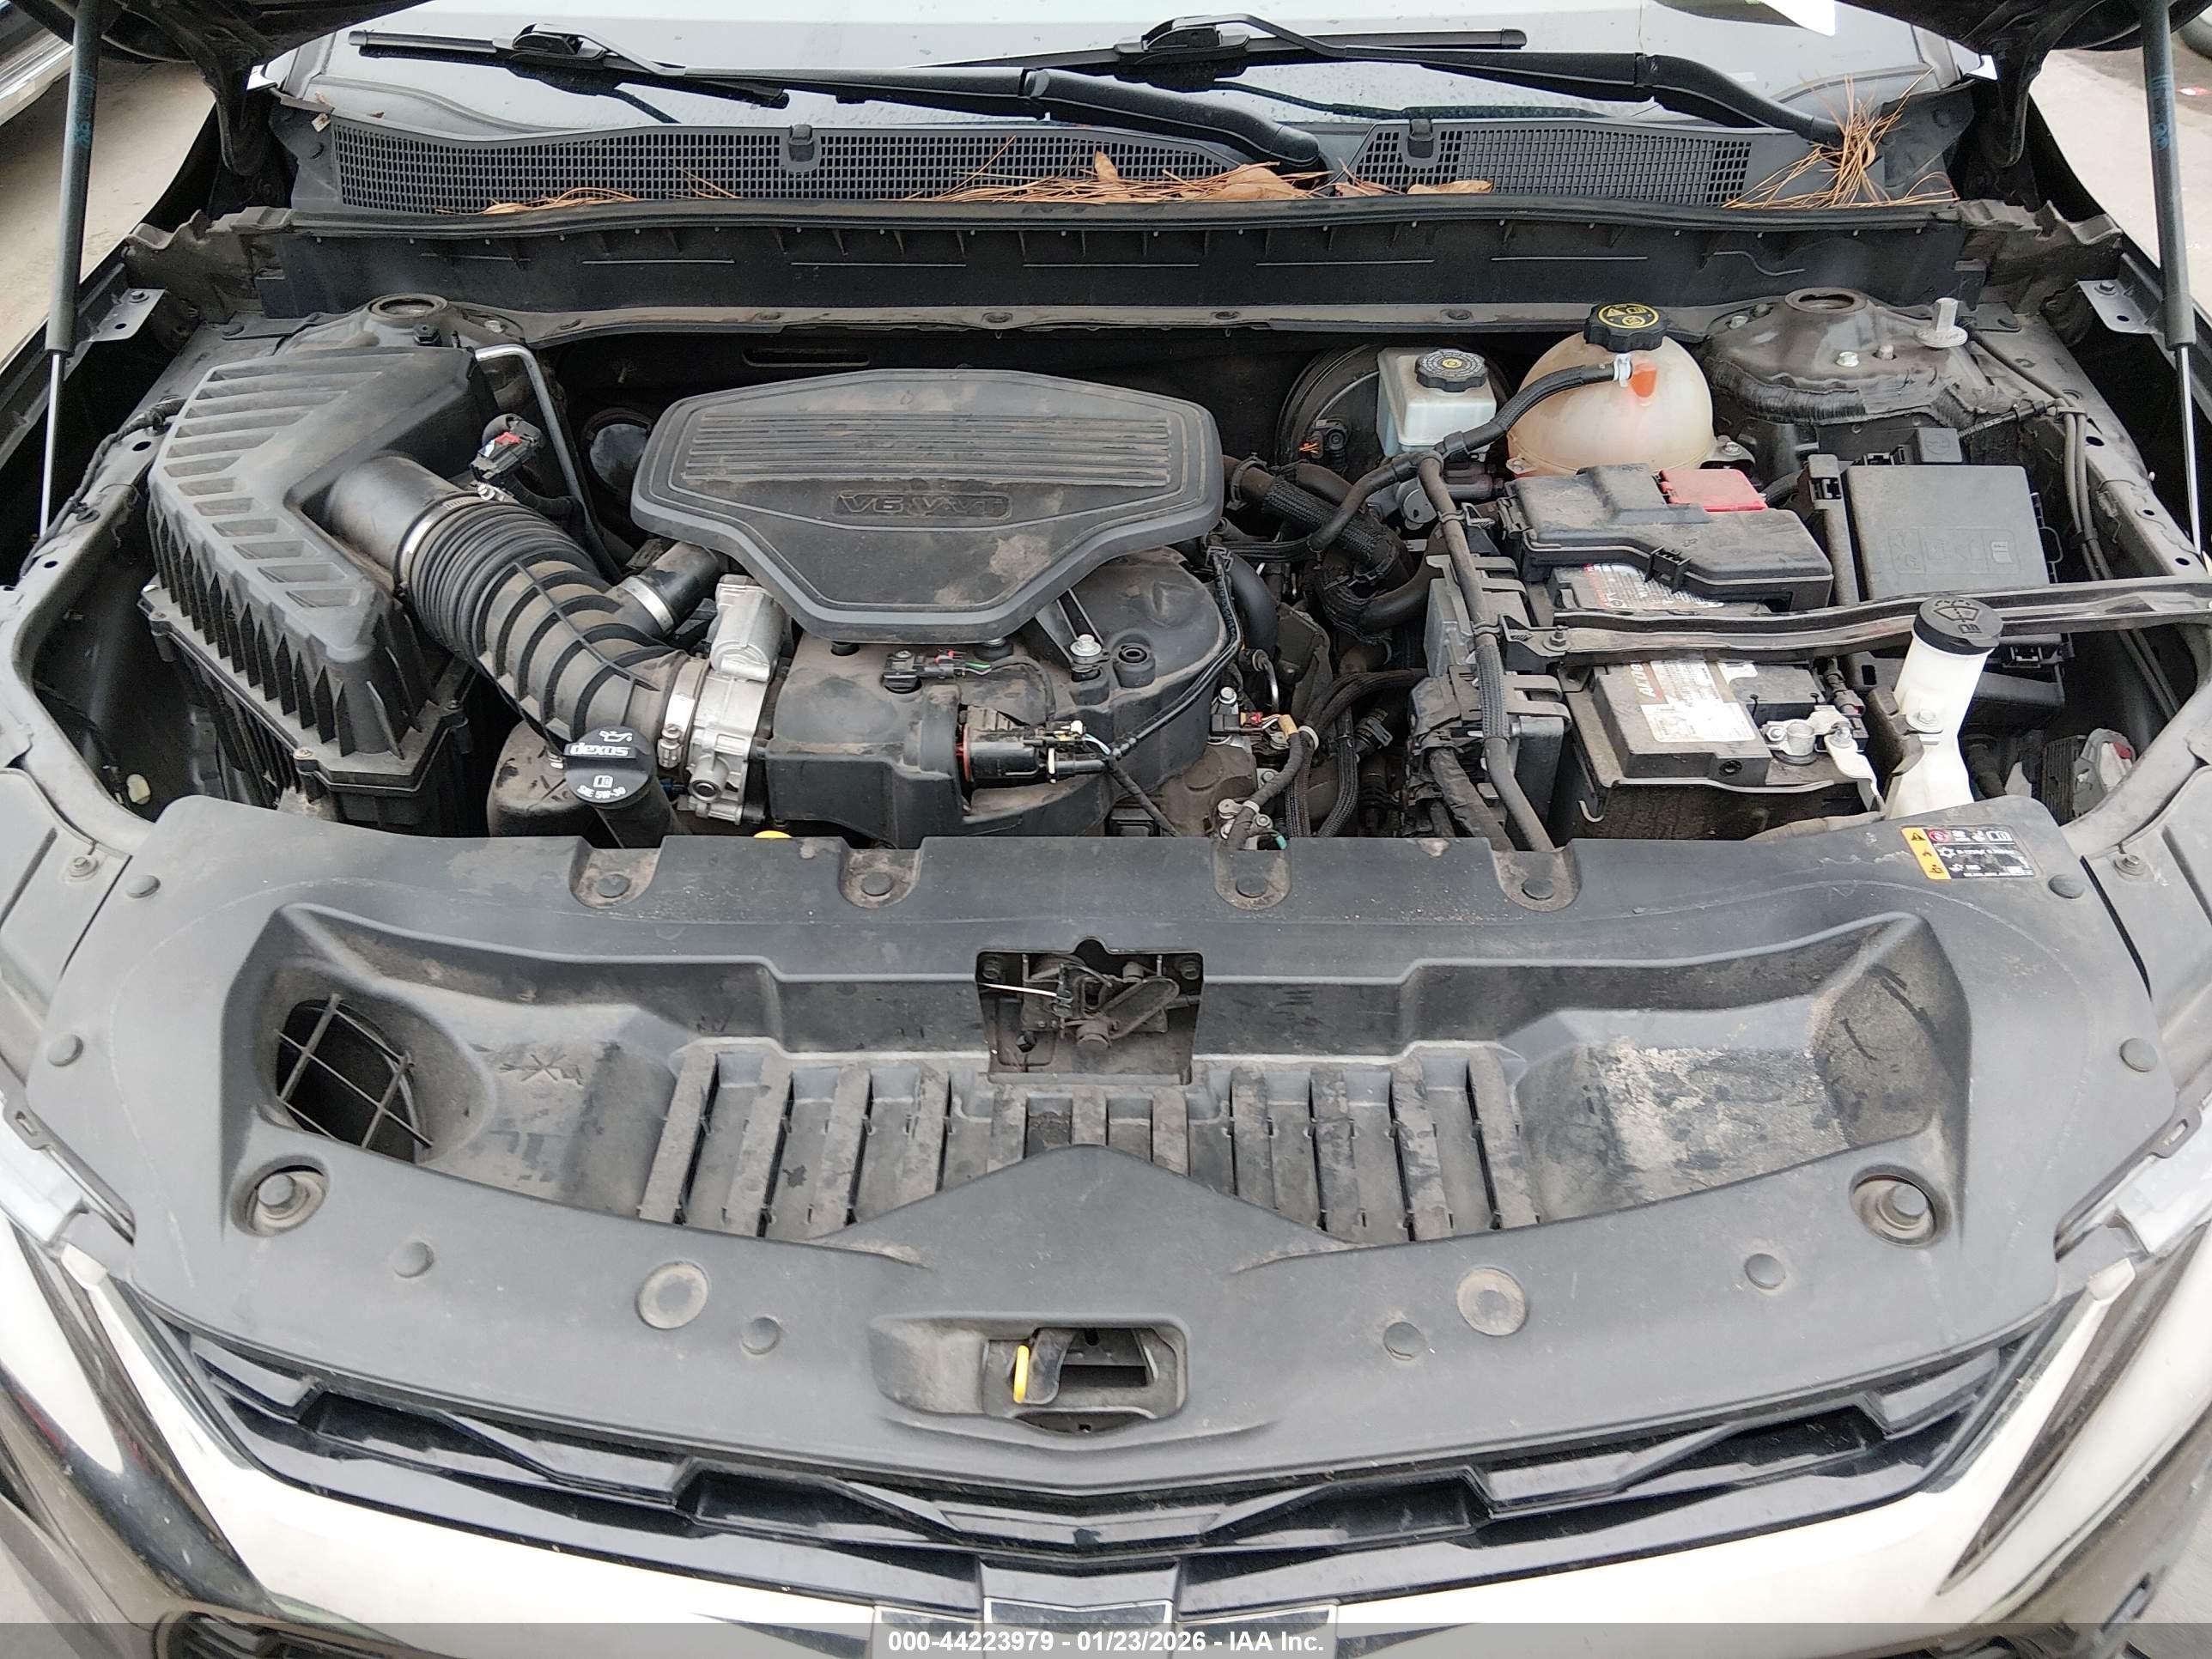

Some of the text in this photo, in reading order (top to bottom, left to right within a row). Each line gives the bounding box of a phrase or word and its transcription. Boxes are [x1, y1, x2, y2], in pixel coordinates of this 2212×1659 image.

[569, 742, 631, 757] dexos
[576, 785, 626, 799] SAE 5W-30
